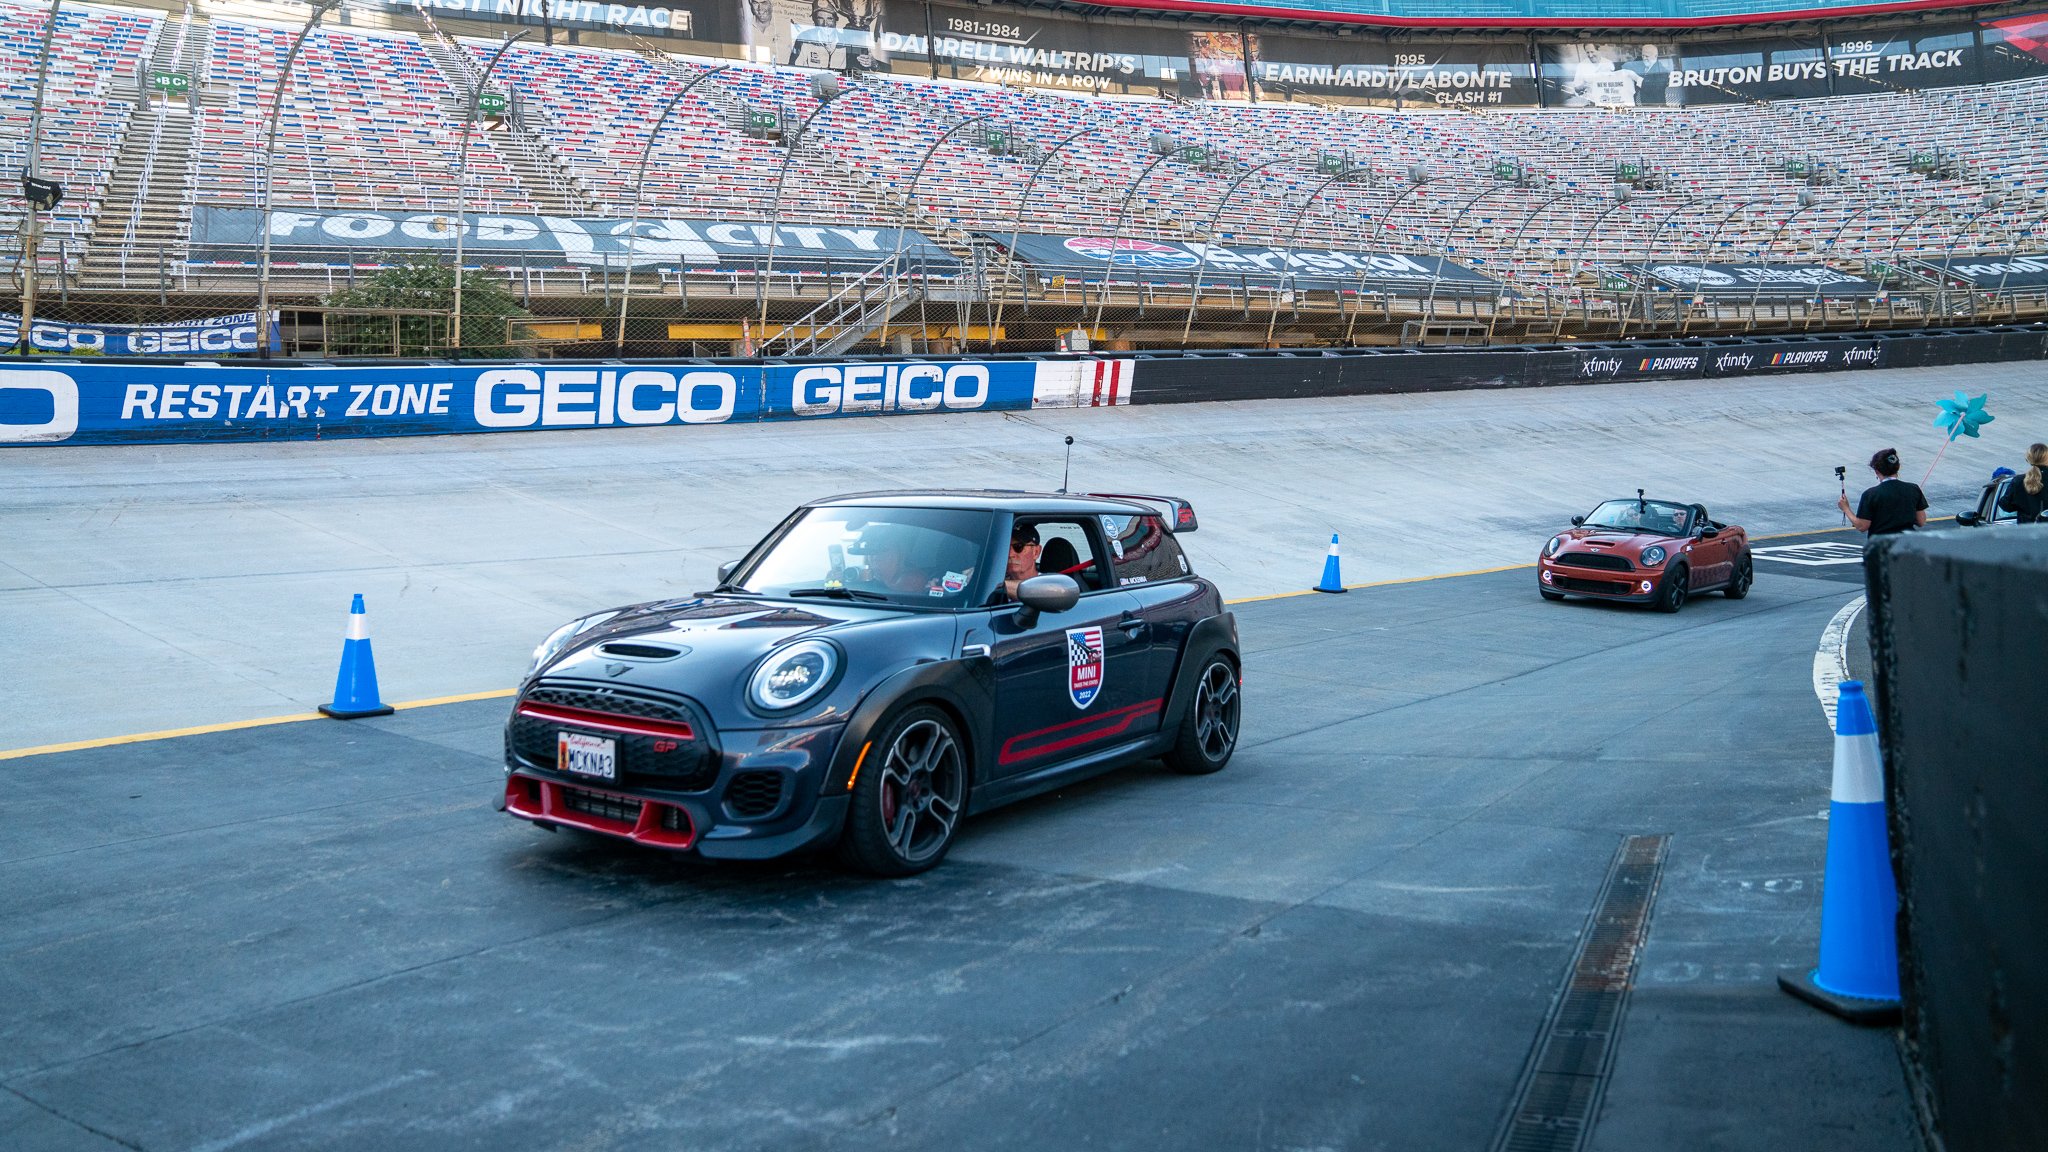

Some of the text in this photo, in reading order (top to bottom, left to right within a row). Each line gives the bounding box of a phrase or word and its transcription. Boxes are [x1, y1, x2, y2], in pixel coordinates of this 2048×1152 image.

[495, 0, 598, 22] NIGHT
[606, 4, 692, 31] RACE
[948, 18, 1020, 39] 1981-1984
[882, 31, 1135, 74] DARRELL WALTRIP'S
[1841, 40, 1873, 54] 1996
[1394, 54, 1425, 66] 1995
[1668, 49, 1963, 88] BRUTON BUYS THE TRACK
[162, 77, 182, 86] B C
[975, 65, 1111, 89] 7 WINS IN A ROW
[1265, 64, 1513, 92] EARNHARDT/LABONTE
[483, 98, 499, 107] C D
[1435, 91, 1503, 104] CLASH #1
[765, 116, 771, 124] E
[261, 211, 881, 250] FOOD CITY
[1183, 242, 1430, 273] Bristol
[213, 311, 255, 326] ZONE
[1582, 346, 1881, 376] xfinity PLAYOFFS xfinity PLAYOFFS xfinity
[121, 382, 453, 420] RESTART ZONE
[474, 369, 736, 428] GEICO
[791, 364, 990, 417] GEICO
[1077, 665, 1096, 681] MINI
[653, 740, 678, 753] GP
